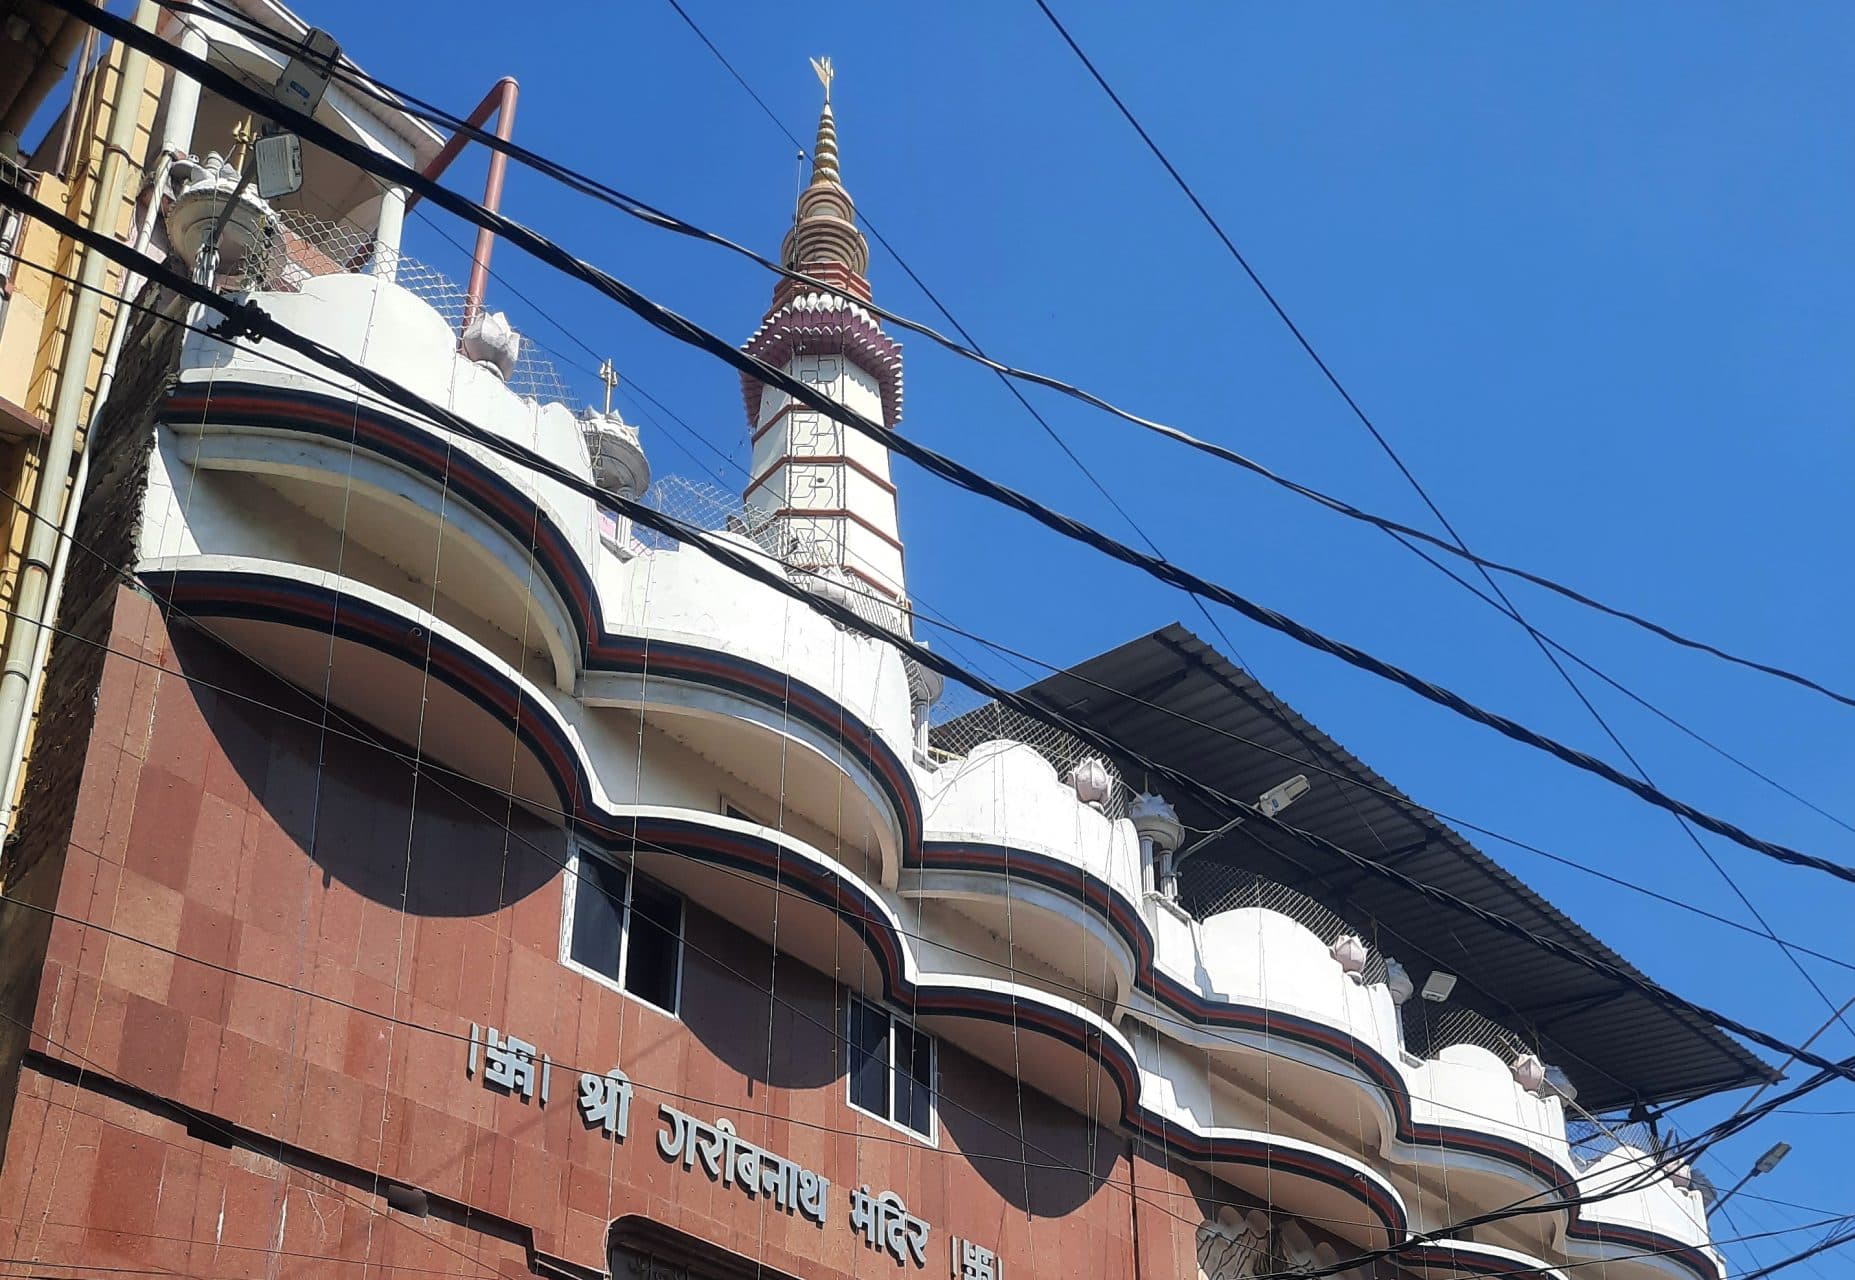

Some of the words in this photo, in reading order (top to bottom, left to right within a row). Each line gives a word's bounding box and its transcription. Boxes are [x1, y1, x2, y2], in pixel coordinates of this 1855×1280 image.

[578, 1068, 633, 1141] श्री
[657, 1104, 829, 1225] गरीबनाथ
[850, 1184, 930, 1267] मंदिर
